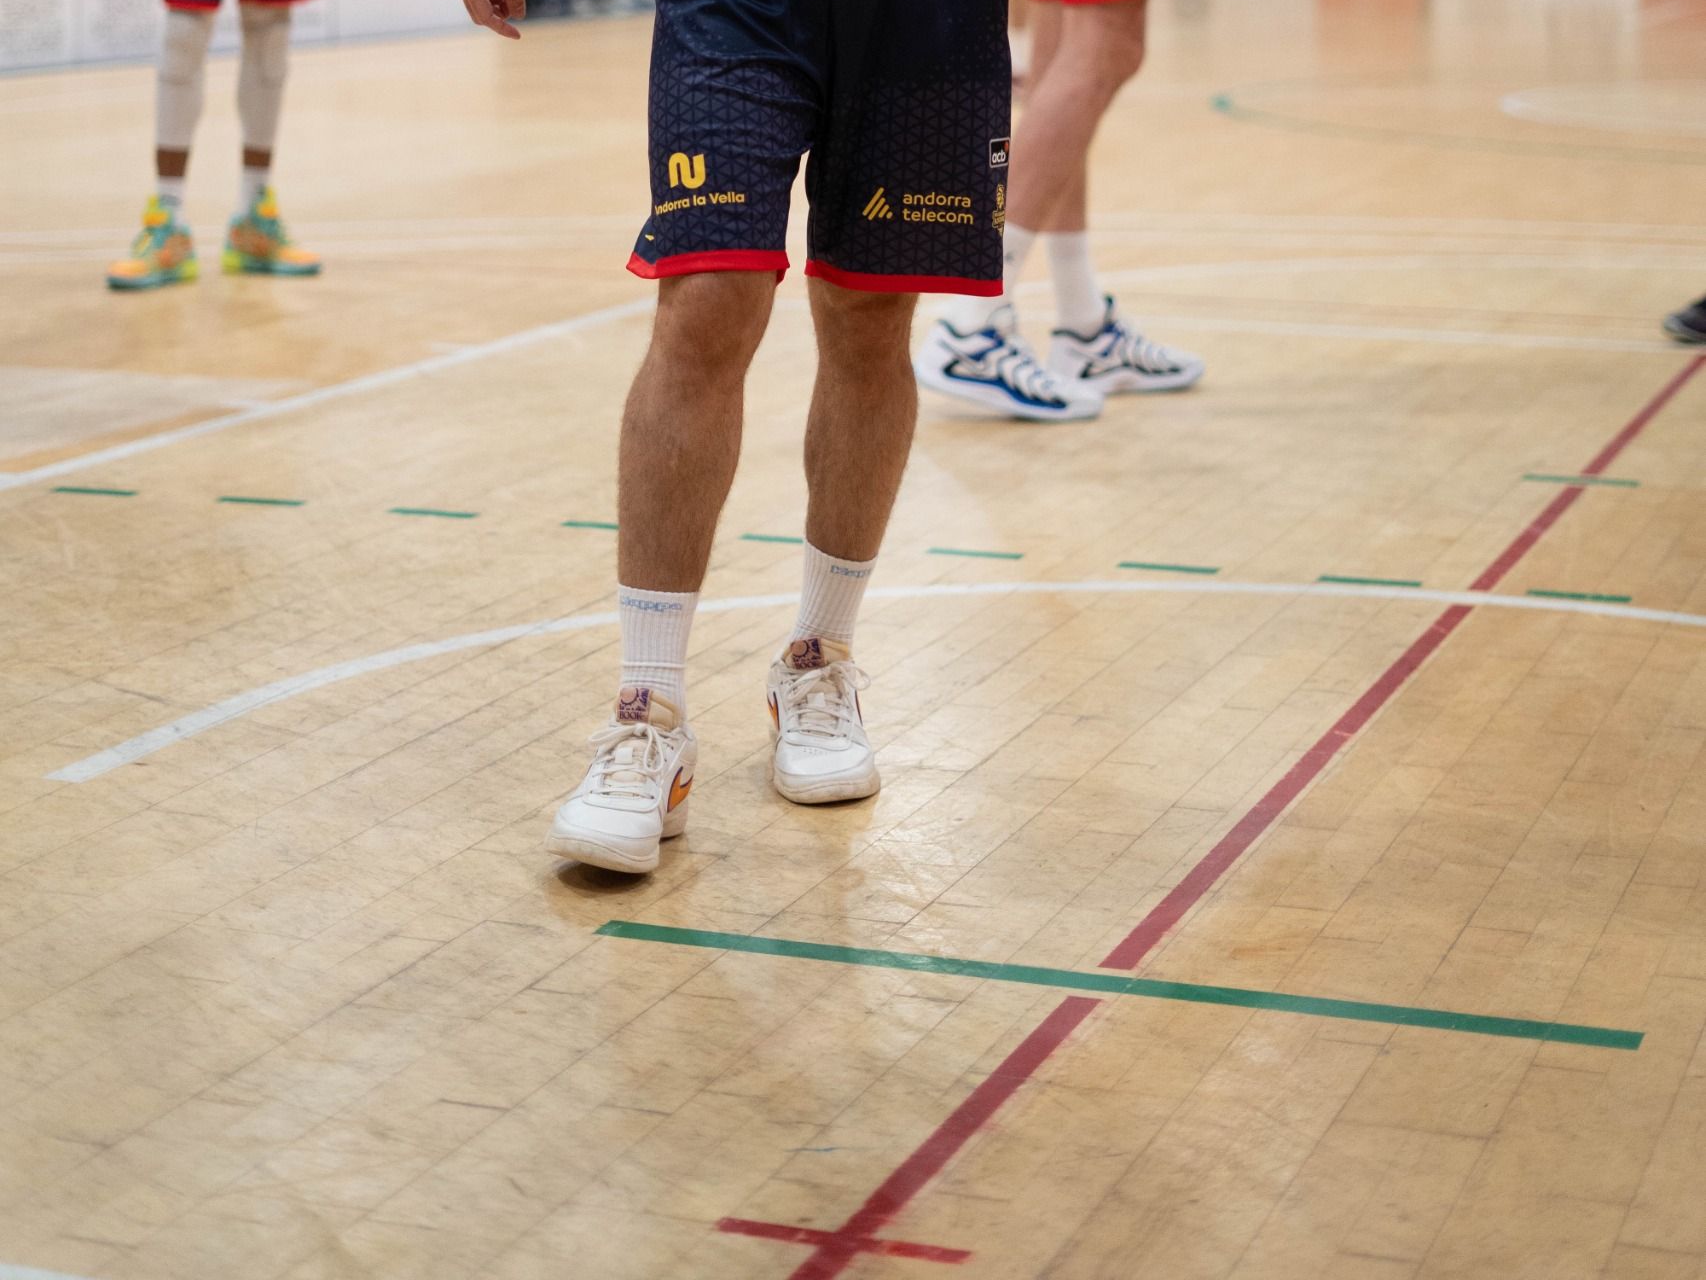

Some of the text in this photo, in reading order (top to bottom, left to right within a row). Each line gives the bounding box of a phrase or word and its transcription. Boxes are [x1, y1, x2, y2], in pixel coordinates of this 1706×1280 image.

[991, 149, 1006, 163] acb
[693, 194, 706, 206] la
[709, 192, 745, 204] Vella
[902, 192, 972, 208] andorra
[902, 208, 974, 225] telecom
